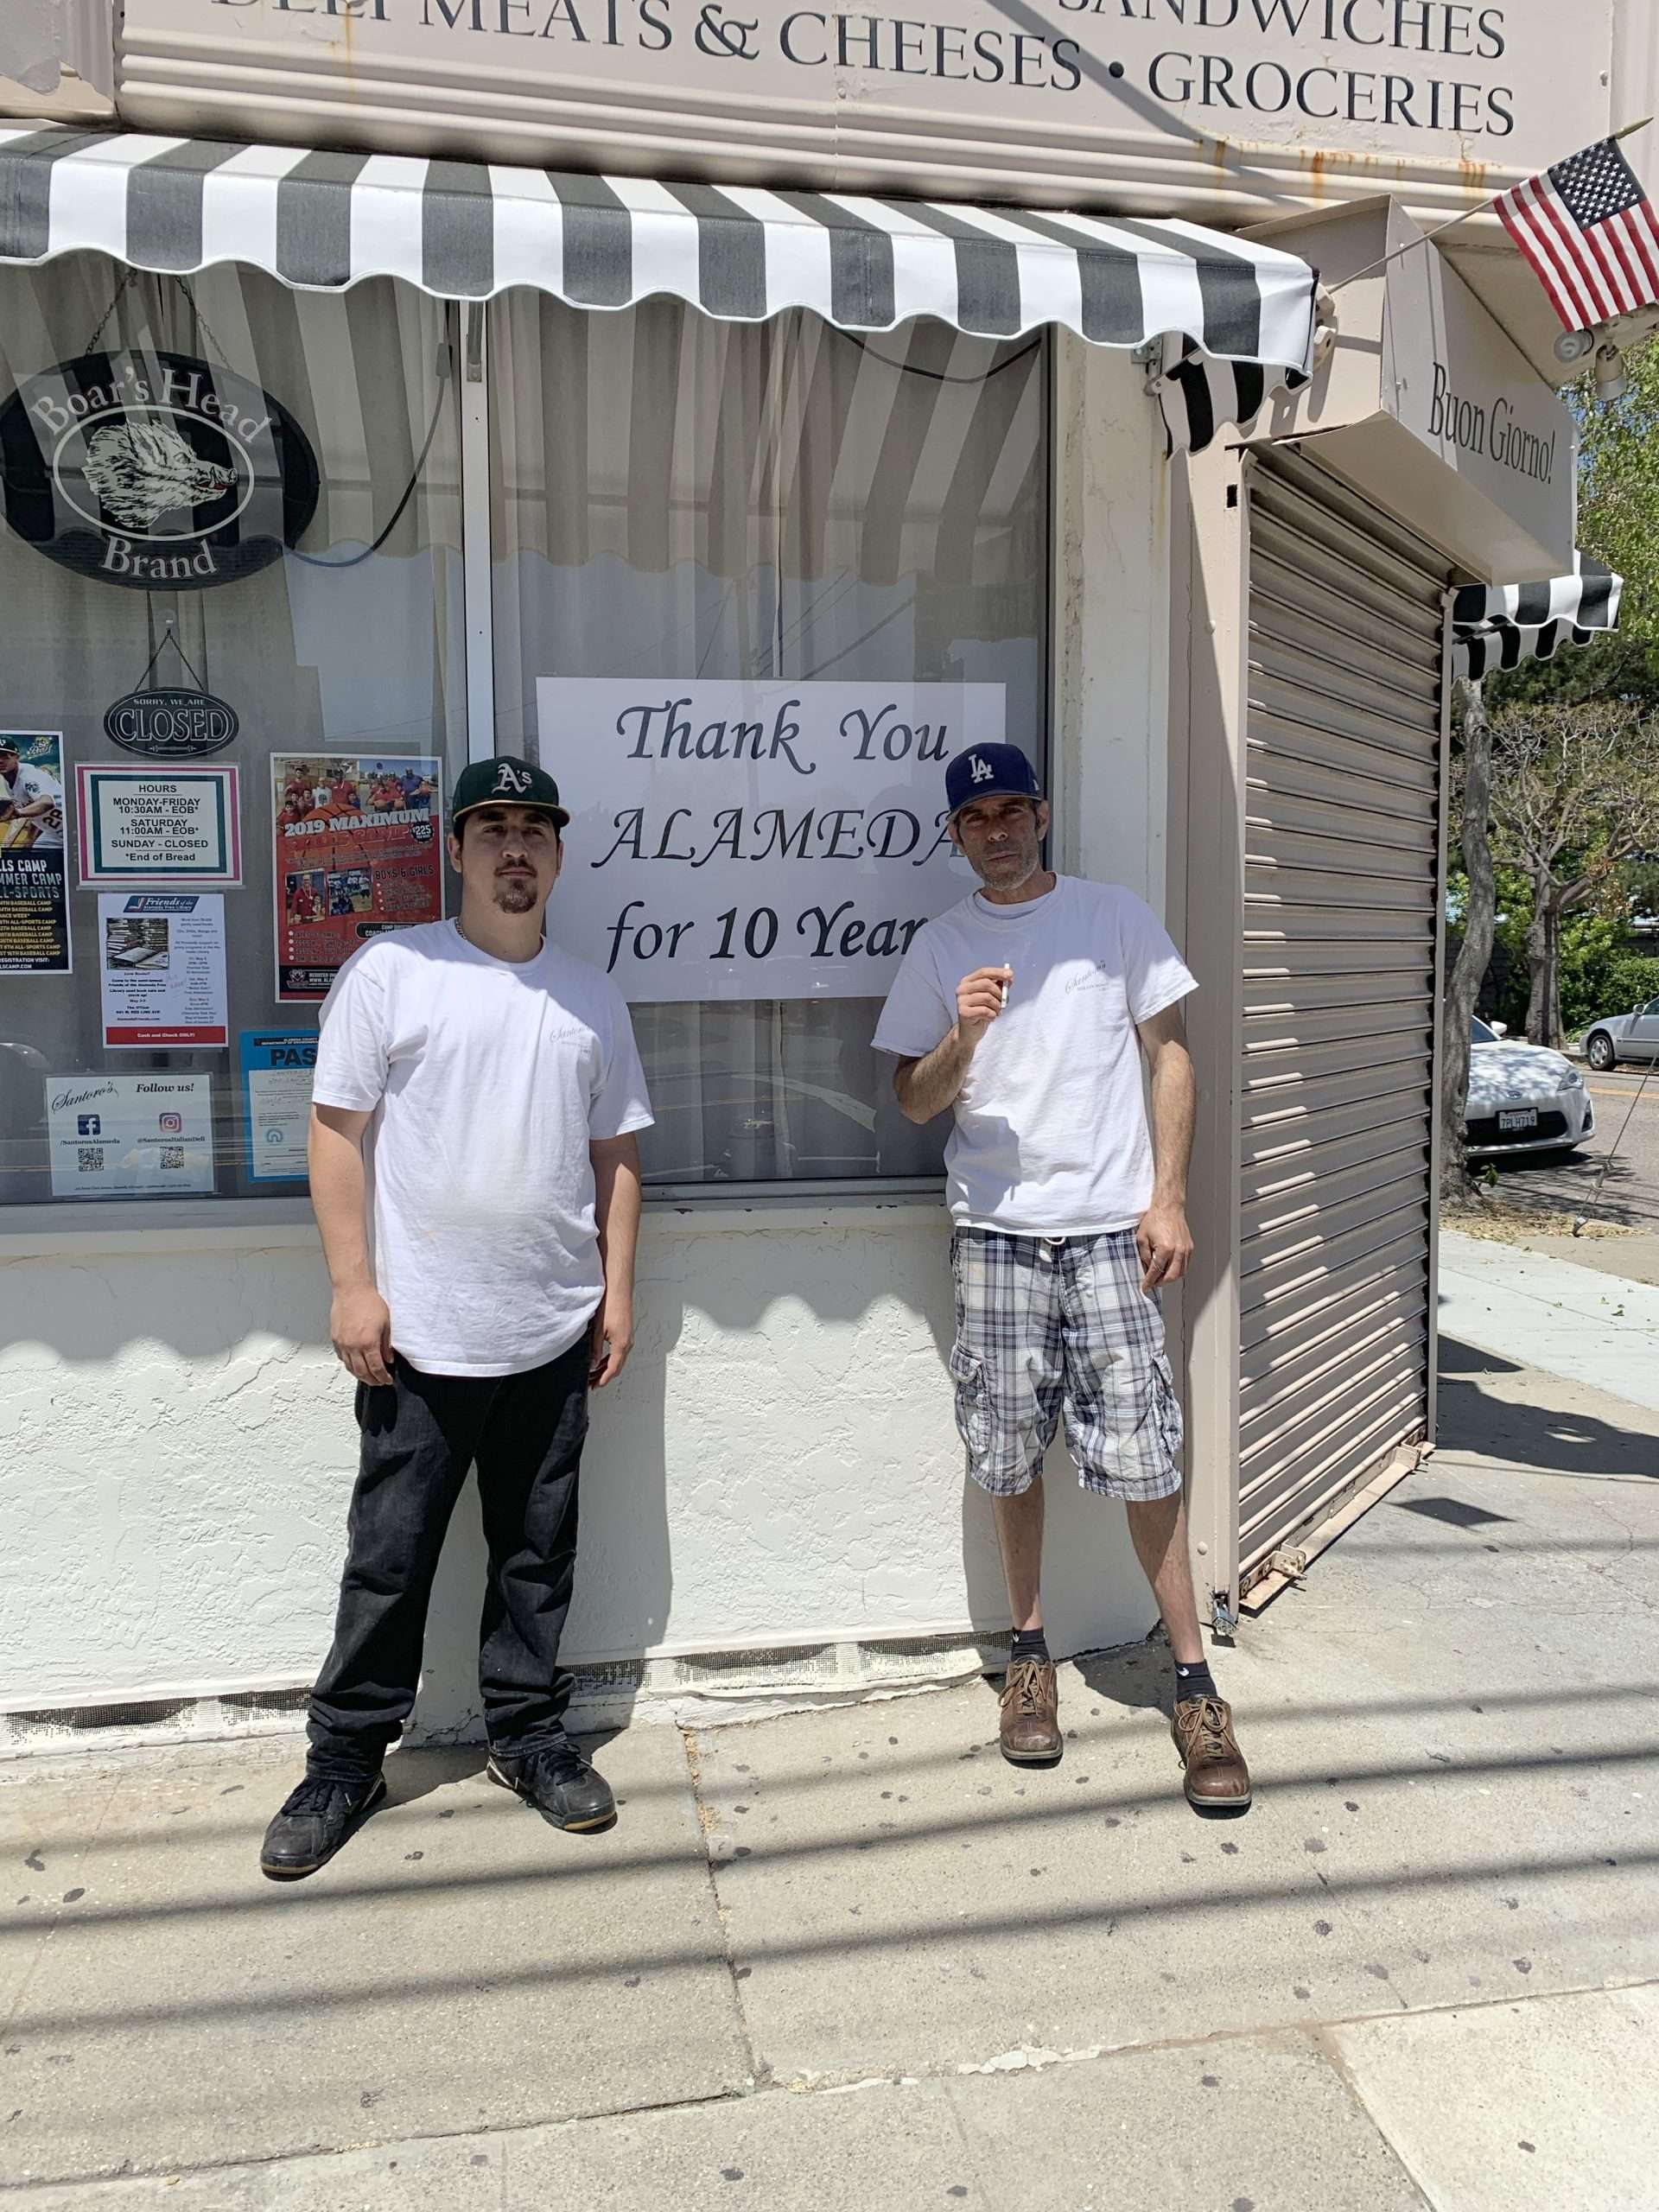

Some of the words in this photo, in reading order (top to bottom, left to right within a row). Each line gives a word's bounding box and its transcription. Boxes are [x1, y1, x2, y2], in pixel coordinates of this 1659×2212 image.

[694, 3, 760, 60] &
[779, 11, 1082, 91] CHEESES
[1148, 52, 1516, 137] GROCERIES
[31, 366, 149, 435] Boar's
[159, 367, 273, 443] Head
[1427, 361, 1484, 454] Buon
[1490, 397, 1555, 484] Giorno!
[99, 534, 218, 579] Brand
[115, 709, 229, 741] CLOSED
[616, 697, 817, 775] Thank
[839, 703, 949, 761] You
[491, 762, 533, 793] A's
[968, 753, 995, 784] LA
[113, 798, 200, 806] MONDAY-FRIDAY
[138, 785, 177, 793] HOURS
[284, 818, 325, 837] 2019
[328, 807, 429, 833] MAXIMUM
[590, 807, 965, 868] ALAMEDA
[0, 859, 15, 872] LS
[17, 860, 47, 872] CAMP
[32, 873, 62, 885] CAMP
[606, 900, 695, 974] for
[709, 906, 779, 959] 10
[52, 1080, 119, 1114] Santoro's
[136, 1084, 175, 1092] Follow
[177, 1083, 194, 1092] us!
